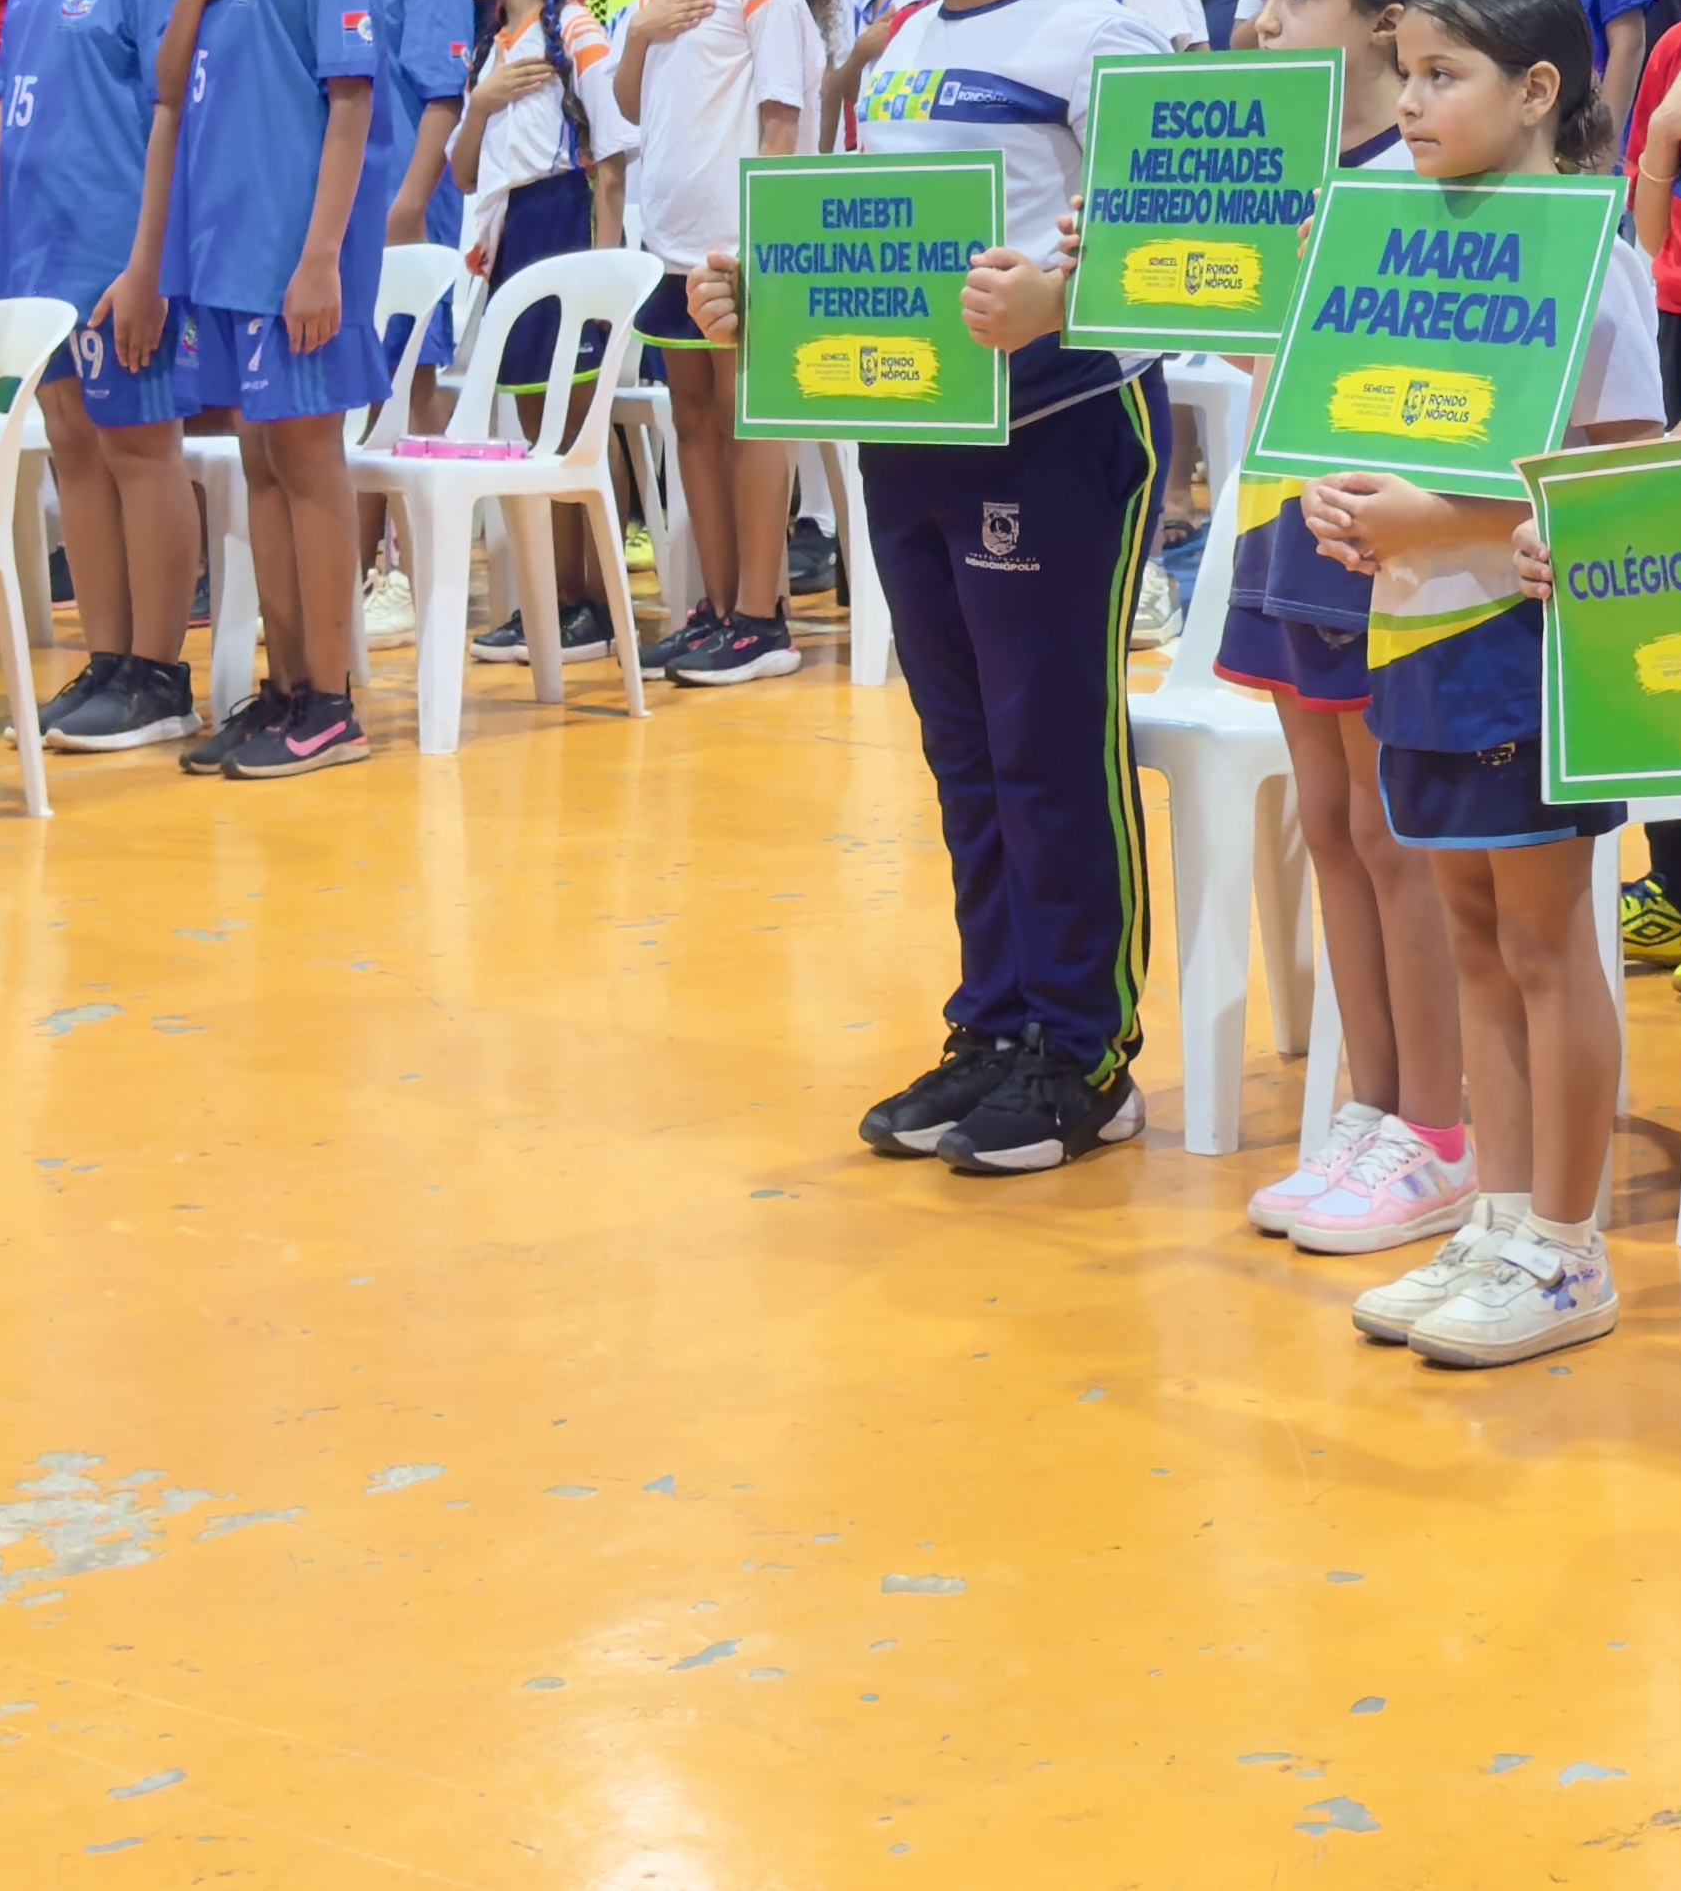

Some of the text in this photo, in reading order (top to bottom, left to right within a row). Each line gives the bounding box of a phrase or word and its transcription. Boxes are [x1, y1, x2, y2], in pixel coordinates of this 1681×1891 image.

[6, 75, 38, 127] 15
[1151, 100, 1266, 139] ESCOLA
[1129, 147, 1284, 184] MELCHIADES
[822, 197, 913, 229] EMEBTI
[1090, 188, 1316, 225] FIGUEIREDO MIRANDA
[755, 242, 875, 274] VIRGILINA
[880, 241, 912, 273] DE
[1377, 228, 1519, 282] MARIA
[808, 286, 930, 318] FERREIRA
[1311, 285, 1556, 348] APARECIDA
[881, 357, 915, 368] RONDO
[1428, 394, 1467, 406] RONDO
